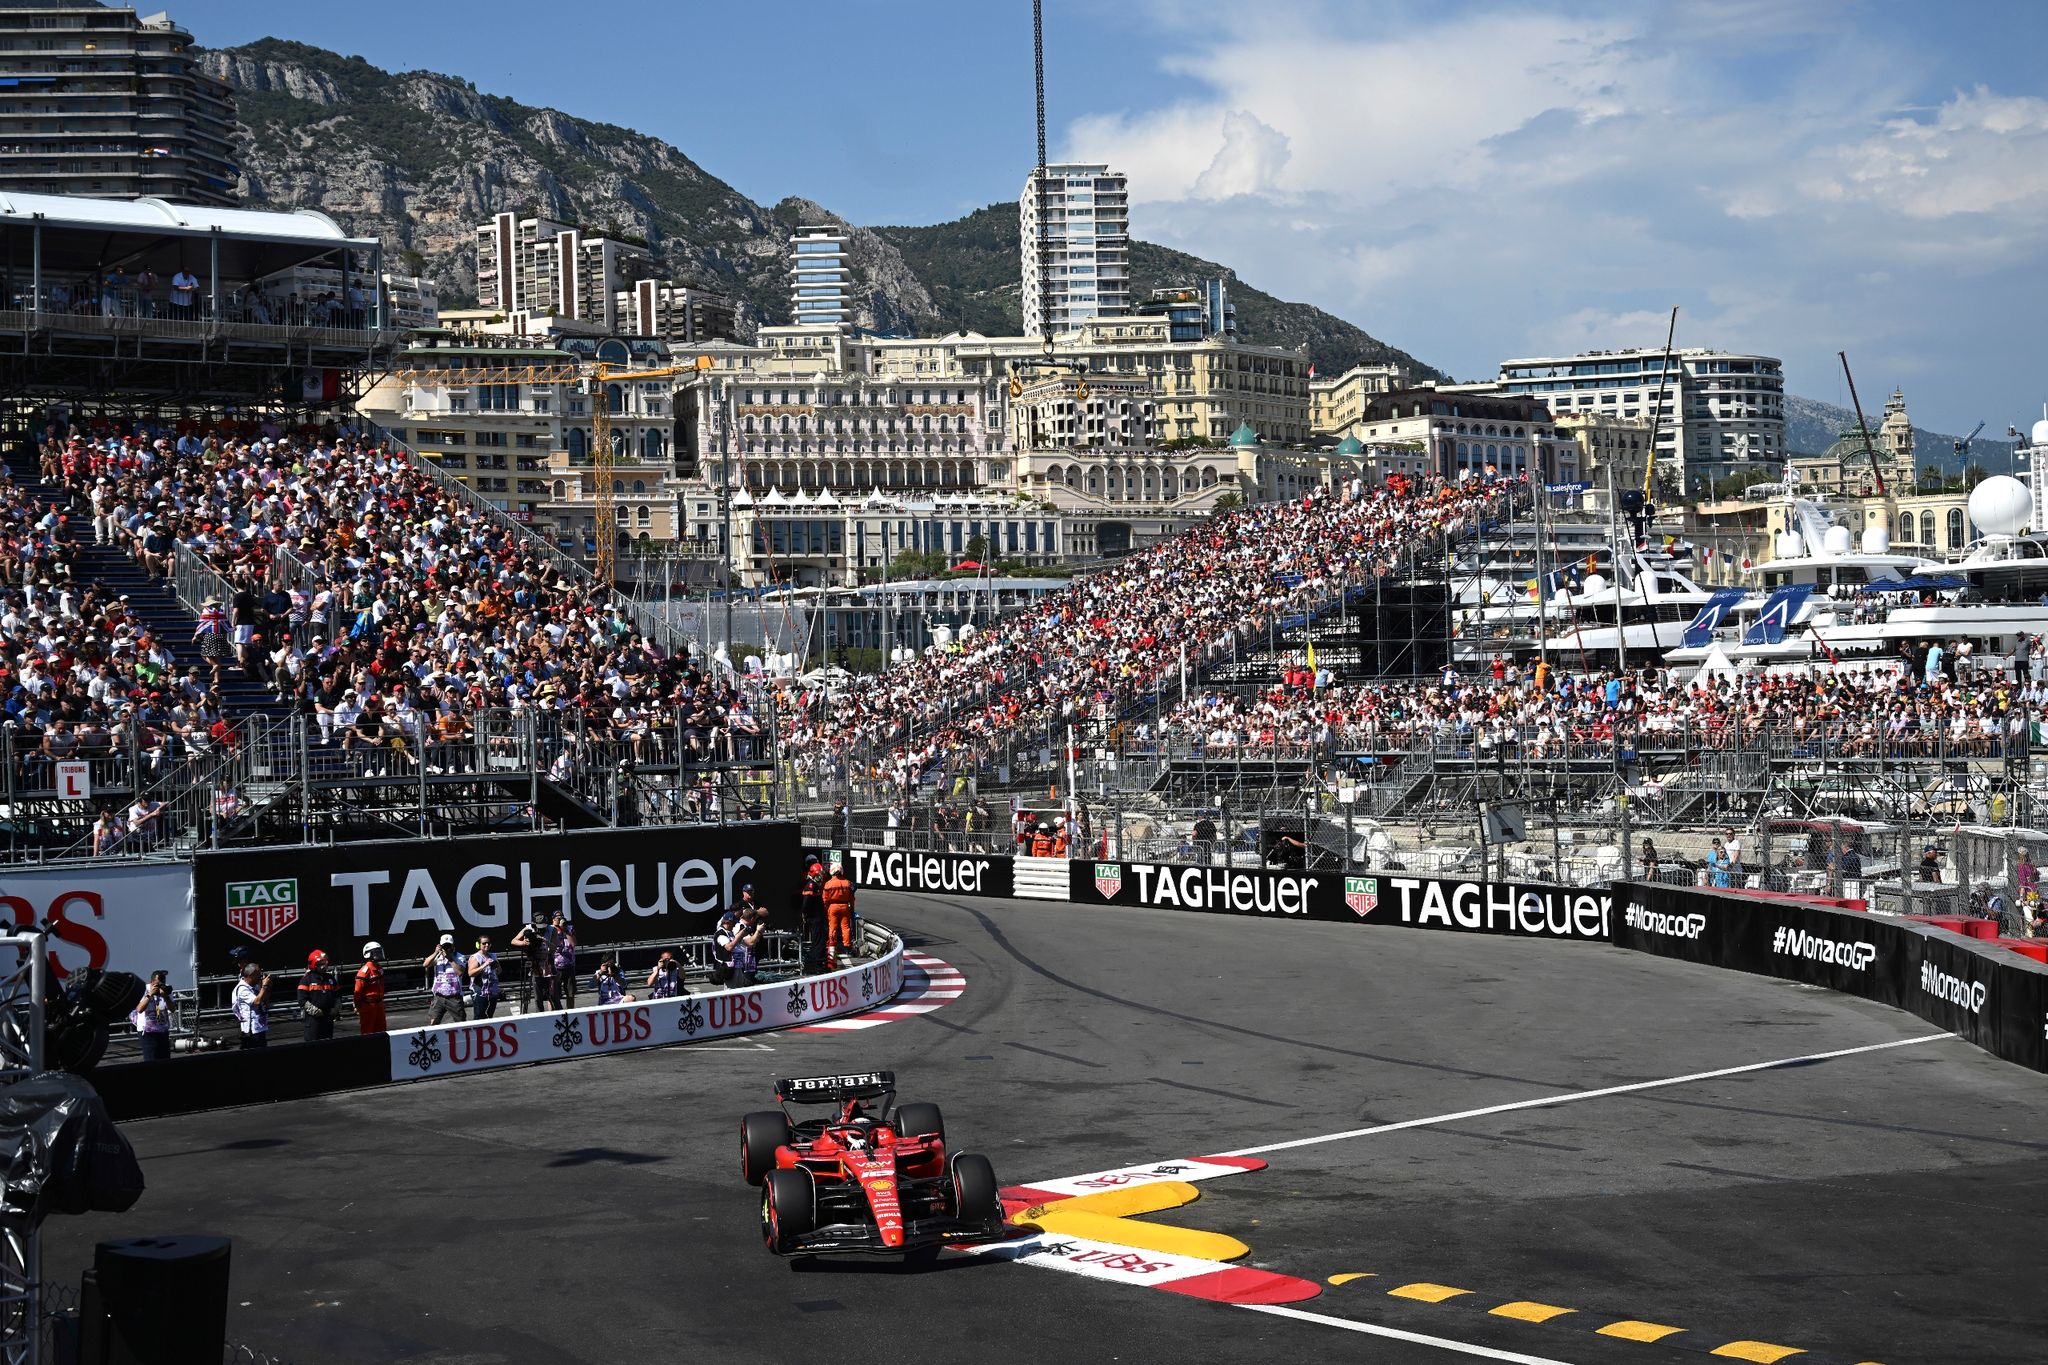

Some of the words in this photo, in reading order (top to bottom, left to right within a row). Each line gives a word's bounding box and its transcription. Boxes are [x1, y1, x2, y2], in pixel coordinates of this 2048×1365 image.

[1552, 482, 1582, 493] salesforce
[67, 776, 81, 795] L
[1097, 865, 1120, 878] TAG
[232, 883, 291, 905] TAG
[1097, 878, 1121, 897] HEUER
[1347, 879, 1375, 894] TAG
[1347, 893, 1377, 915] HEUER
[231, 907, 294, 937] HEUER
[1625, 902, 1706, 939] #MonacoGP
[1772, 925, 1876, 971] #MonacoGP
[873, 961, 892, 996] UBS
[809, 976, 850, 1012] UBS
[707, 991, 763, 1029] UBS
[586, 1006, 652, 1046] UBS
[445, 1022, 519, 1064] UBS
[791, 1075, 882, 1090] Ferrari
[1068, 1250, 1175, 1274] UBS
